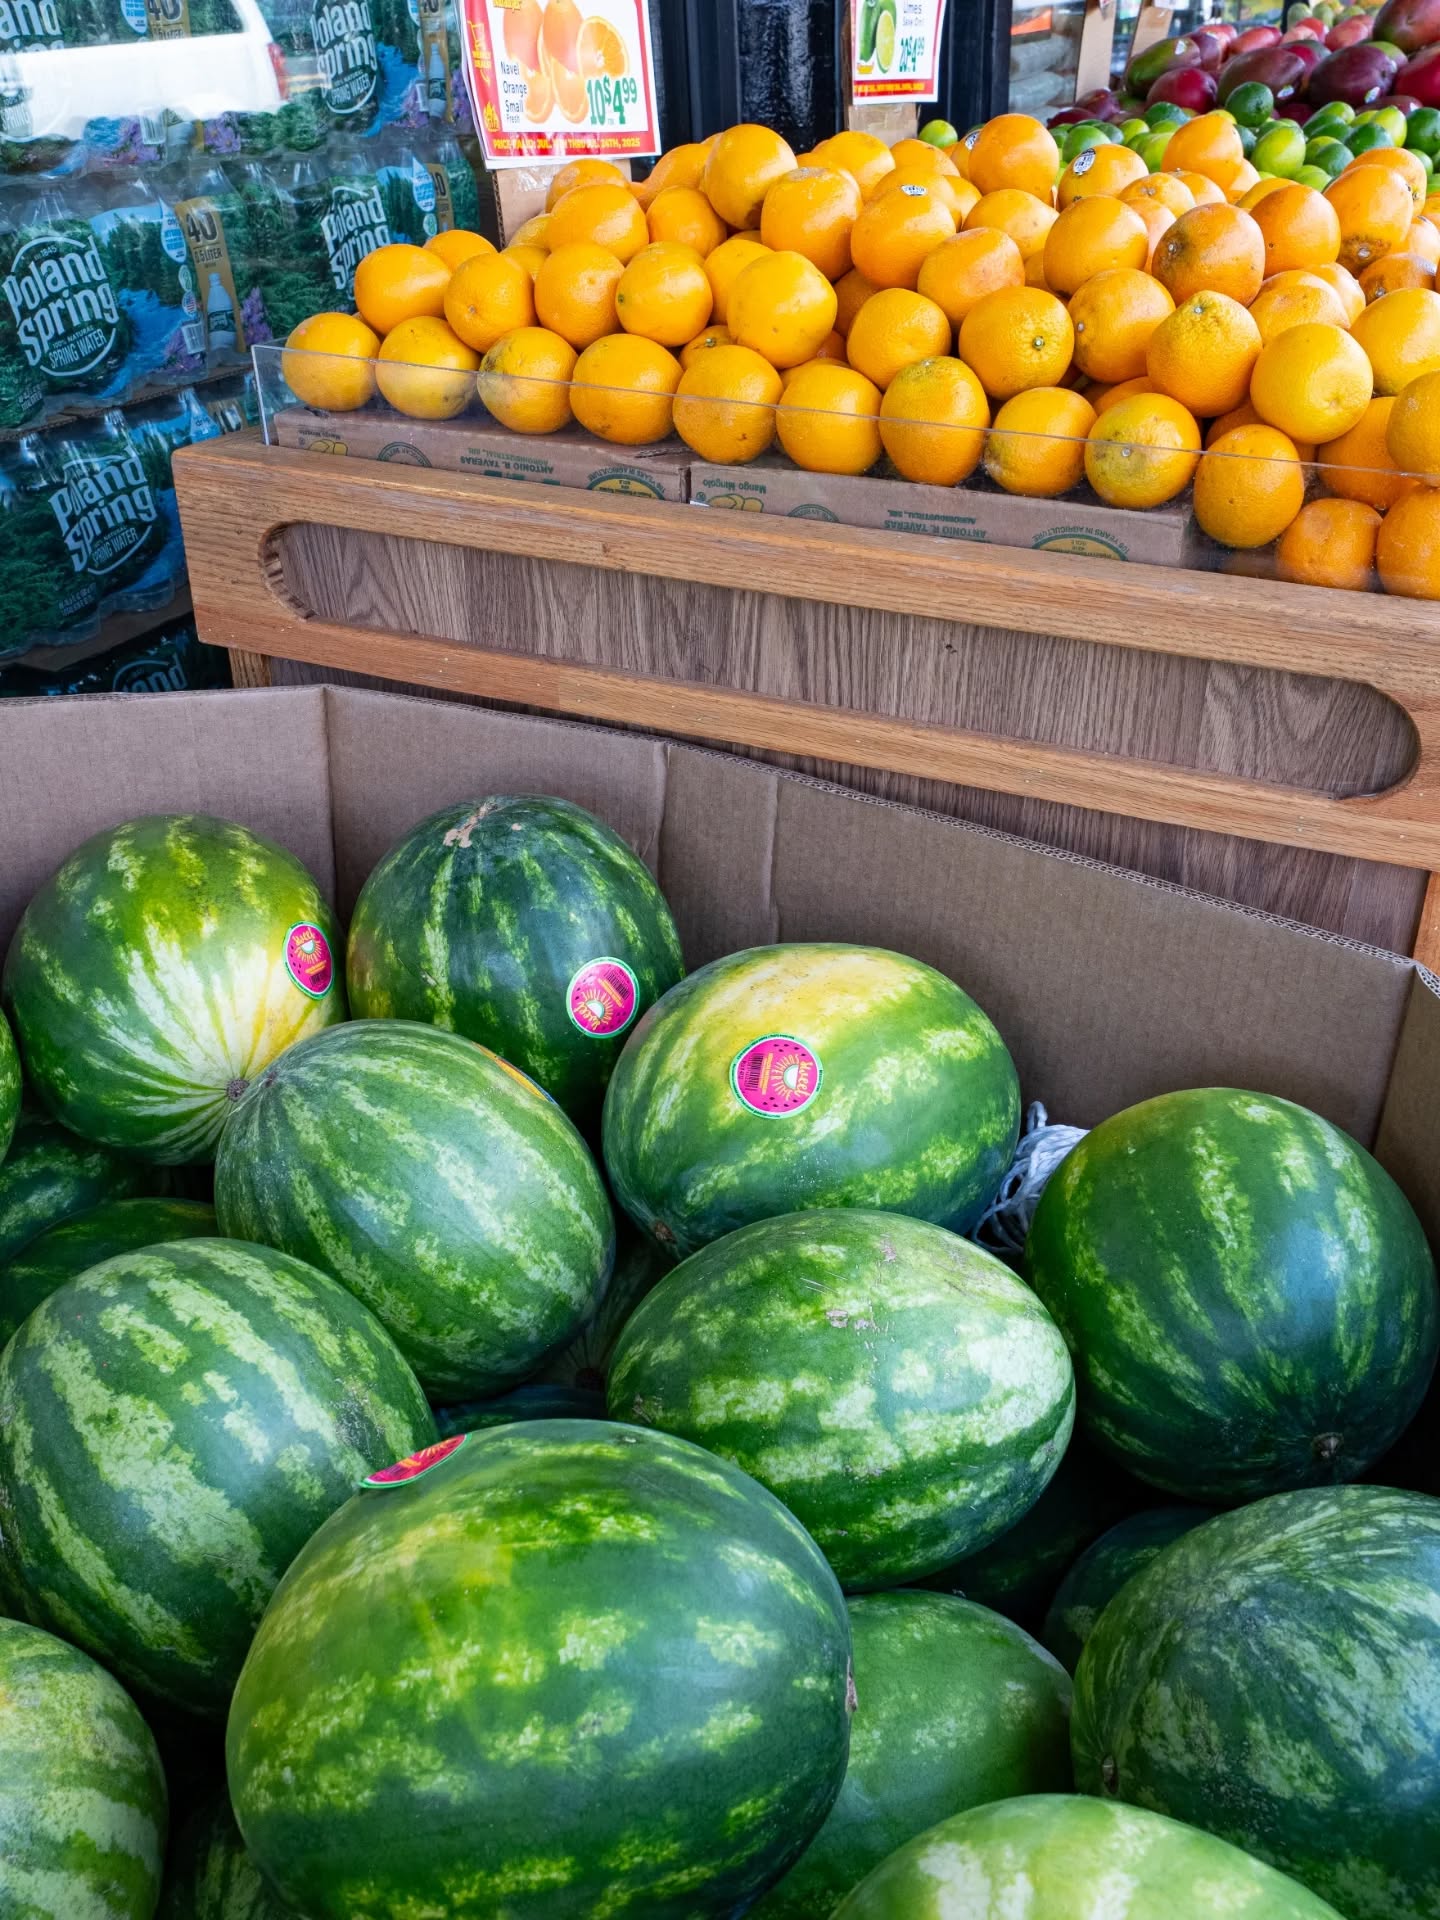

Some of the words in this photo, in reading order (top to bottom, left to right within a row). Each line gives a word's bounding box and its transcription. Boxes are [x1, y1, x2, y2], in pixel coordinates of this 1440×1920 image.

[500, 61, 520, 75] Navel
[503, 80, 528, 98] Orange
[505, 99, 524, 113] Small
[185, 209, 219, 243] 40
[320, 185, 387, 258] Poland
[1, 235, 108, 328] Poland
[17, 283, 120, 366] Spring
[48, 342, 80, 369] SPRING
[77, 328, 108, 358] WATER
[460, 456, 499, 469] TAVERAS
[501, 461, 511, 471] R.
[513, 463, 554, 475] ANTONIO
[48, 445, 148, 537] Poland
[702, 478, 736, 491] Mingolo
[738, 481, 767, 494] Mango
[64, 486, 158, 572] Spring
[884, 520, 927, 533] TAVERAS
[942, 526, 987, 539] ANTONIO
[1031, 525, 1084, 543] AGRICULTURE
[111, 527, 138, 555] WATER
[796, 1060, 814, 1098] Sweet
